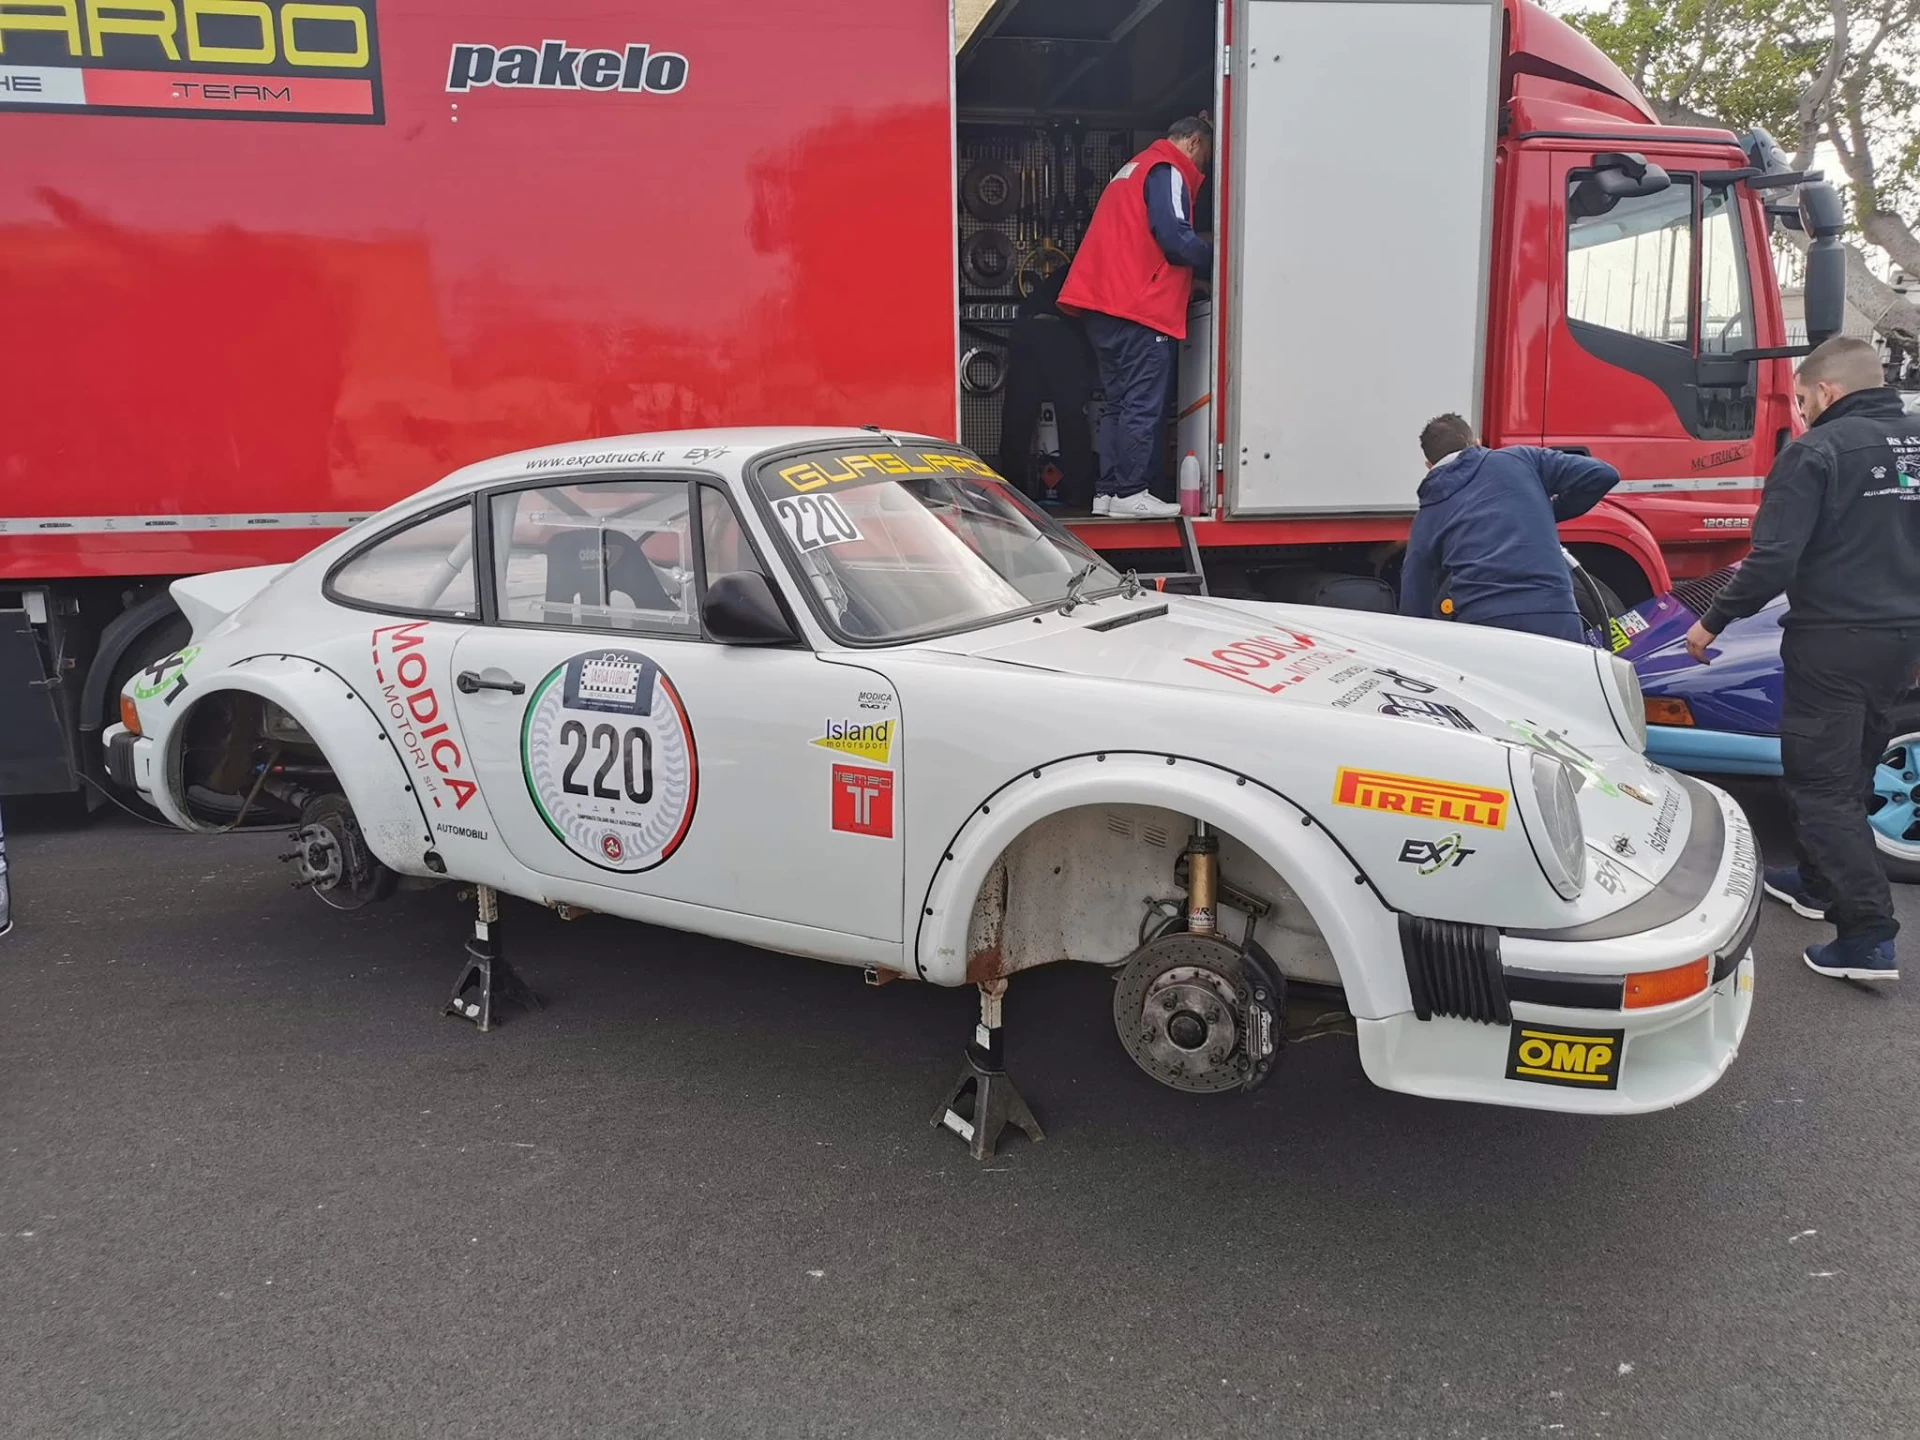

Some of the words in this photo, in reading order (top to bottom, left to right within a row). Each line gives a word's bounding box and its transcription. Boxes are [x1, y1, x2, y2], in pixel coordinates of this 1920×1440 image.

[446, 39, 689, 94] pakelo
[172, 82, 291, 102] TEAM
[526, 451, 665, 469] www.expotruck.it
[776, 494, 857, 549] 220
[1702, 517, 1750, 528] 120E25
[858, 691, 892, 702] MODICA
[373, 621, 477, 810] MODICA
[382, 684, 429, 769] MOTORI
[423, 775, 437, 792] srl
[826, 719, 888, 741] Island
[826, 740, 888, 750] motorsport
[560, 720, 653, 804] 220
[1339, 770, 1505, 826] PIRELLI
[437, 823, 488, 840] AUTOMOBILI
[1519, 1039, 1612, 1072] OMP
